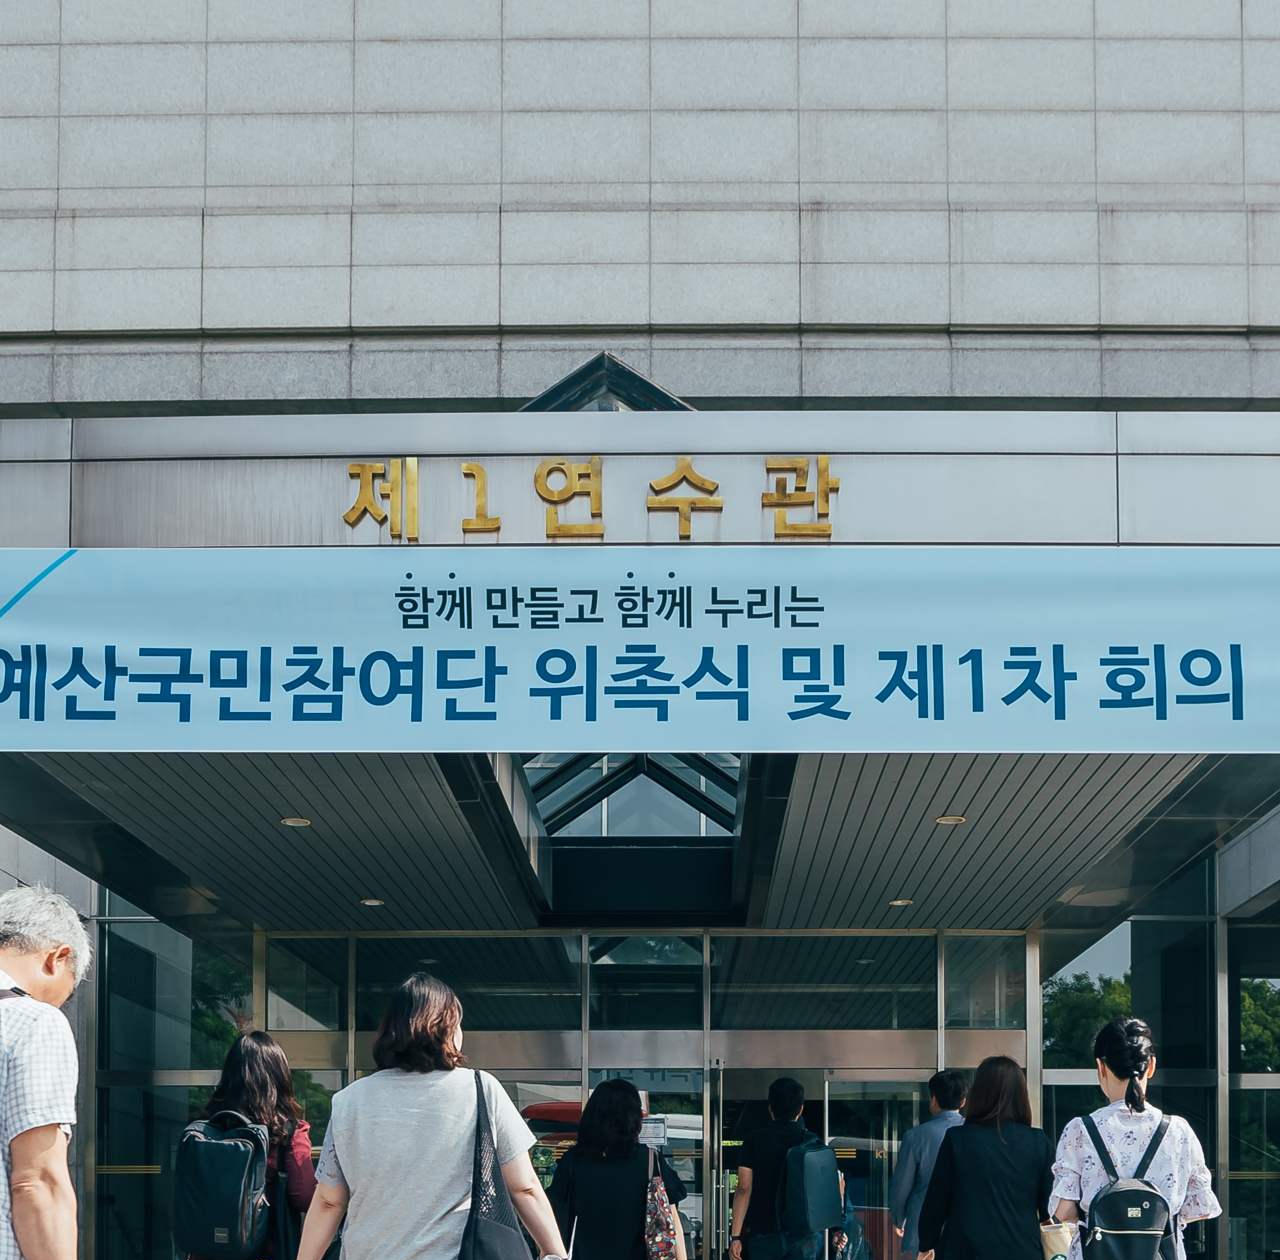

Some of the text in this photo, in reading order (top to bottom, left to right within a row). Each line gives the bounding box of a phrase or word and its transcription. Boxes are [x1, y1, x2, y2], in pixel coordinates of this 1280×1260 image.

[342, 453, 841, 541] 제1연수관
[395, 585, 824, 629] 함께 만들고 함께 누리는
[530, 644, 749, 722] 위촉식
[782, 644, 852, 721] 및
[875, 644, 1078, 720] 제1차
[1099, 643, 1244, 720] 회의
[875, 1148, 887, 1159] kt
